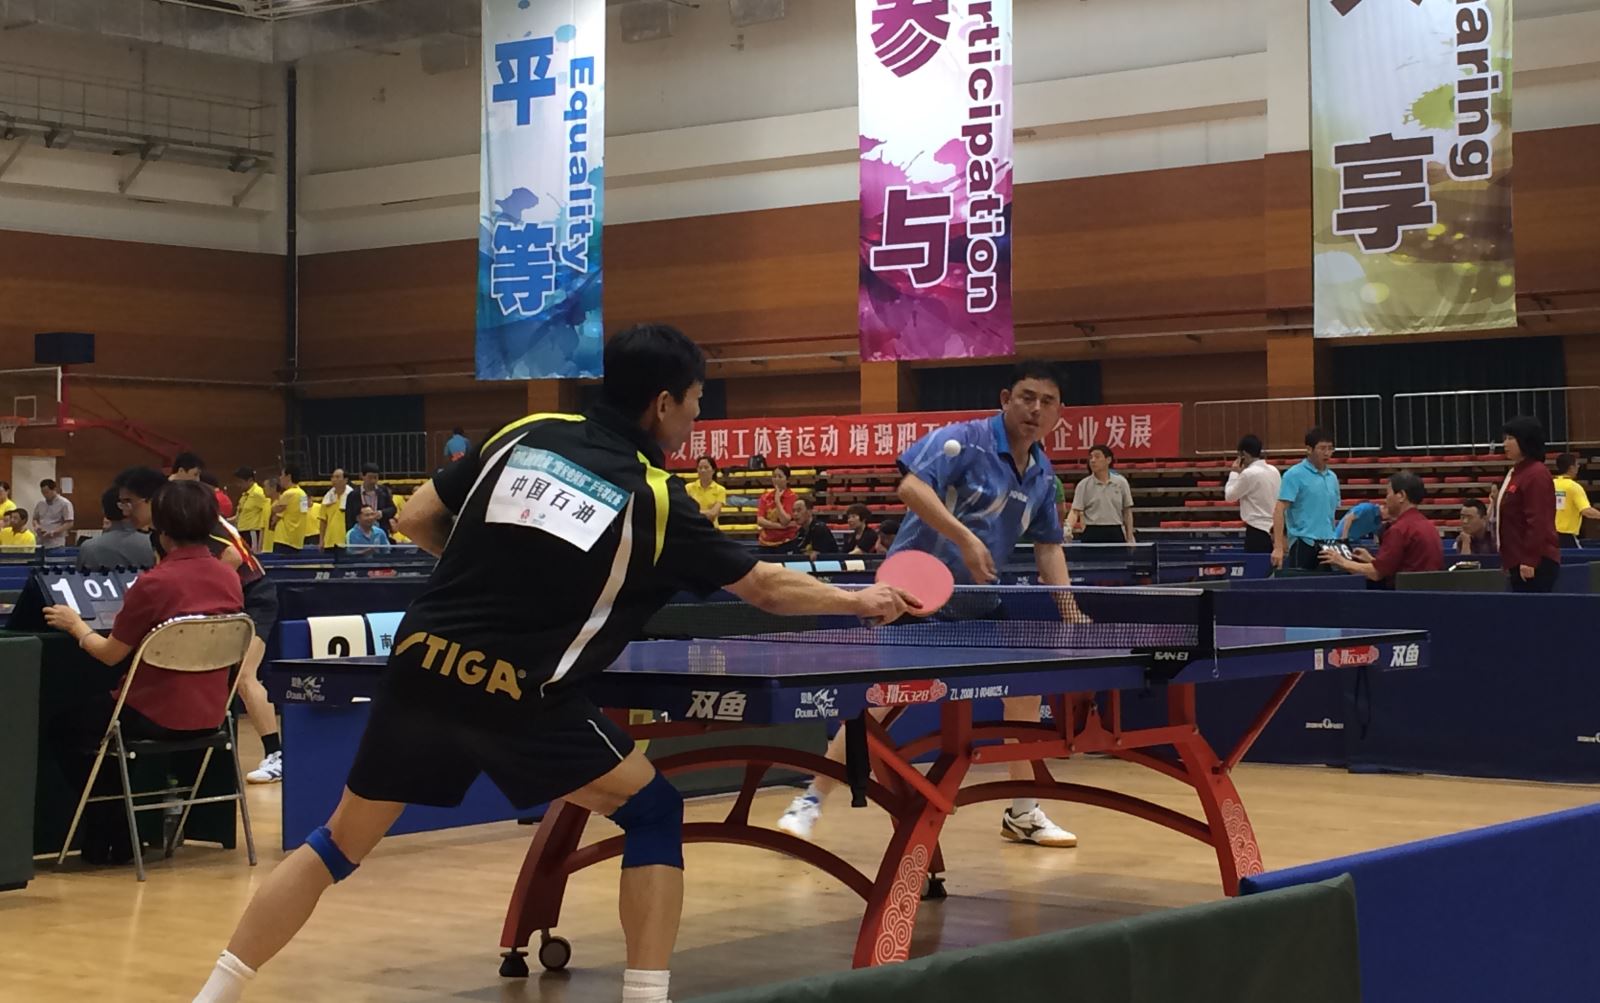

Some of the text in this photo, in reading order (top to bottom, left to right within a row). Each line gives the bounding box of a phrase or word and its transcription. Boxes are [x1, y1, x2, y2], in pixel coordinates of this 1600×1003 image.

[491, 36, 556, 316] 平等
[563, 56, 595, 273] Equality
[870, 0, 953, 288] 参与
[1331, 0, 1434, 251] 享
[1449, 0, 1500, 178] aring
[510, 475, 596, 524] 中国石油
[685, 690, 747, 721] 双鱼
[1390, 643, 1420, 668] 双鱼
